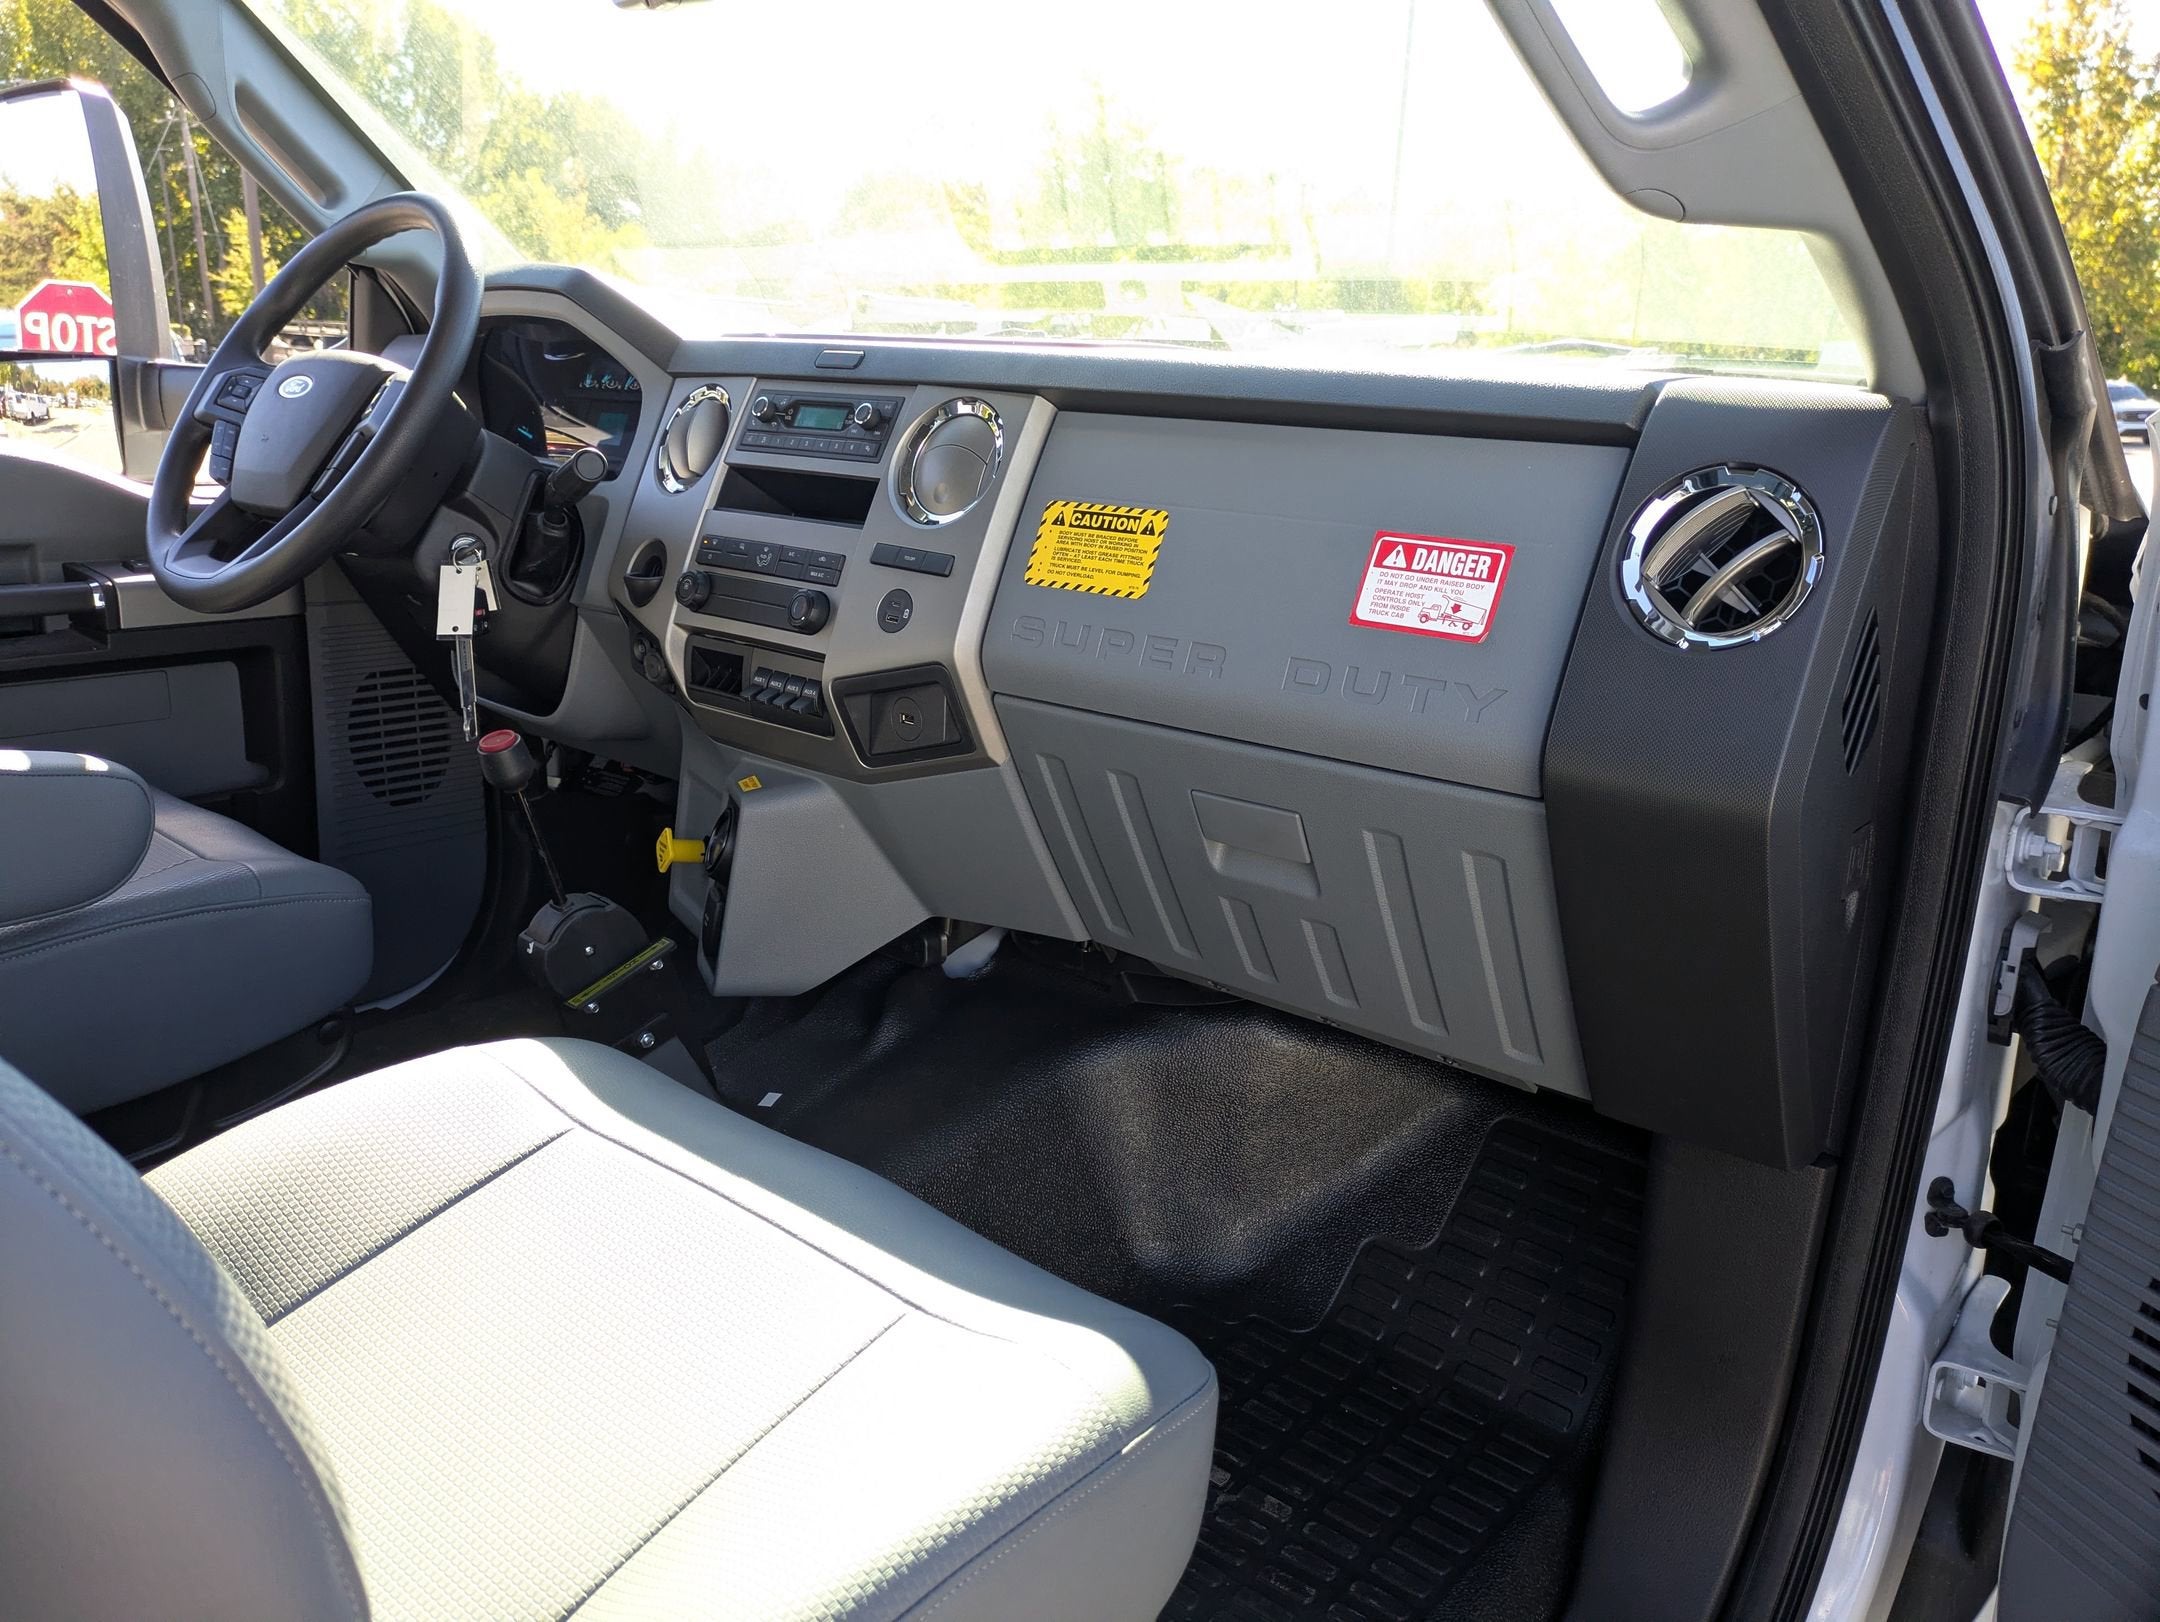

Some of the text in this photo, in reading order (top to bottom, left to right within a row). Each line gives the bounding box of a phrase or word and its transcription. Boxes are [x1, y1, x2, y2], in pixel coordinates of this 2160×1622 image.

[1071, 513, 1140, 532] CAUTION
[1411, 548, 1491, 579] DANGER
[1440, 579, 1464, 587] RAISED
[1466, 582, 1485, 590] BODY
[1375, 588, 1424, 600] OPERATE HOIST
[1373, 595, 1407, 605] CONTROLS
[1370, 602, 1389, 610] FROM
[1368, 609, 1404, 619] TRUCK CAB
[1010, 615, 1508, 725] SUPER DUTY
